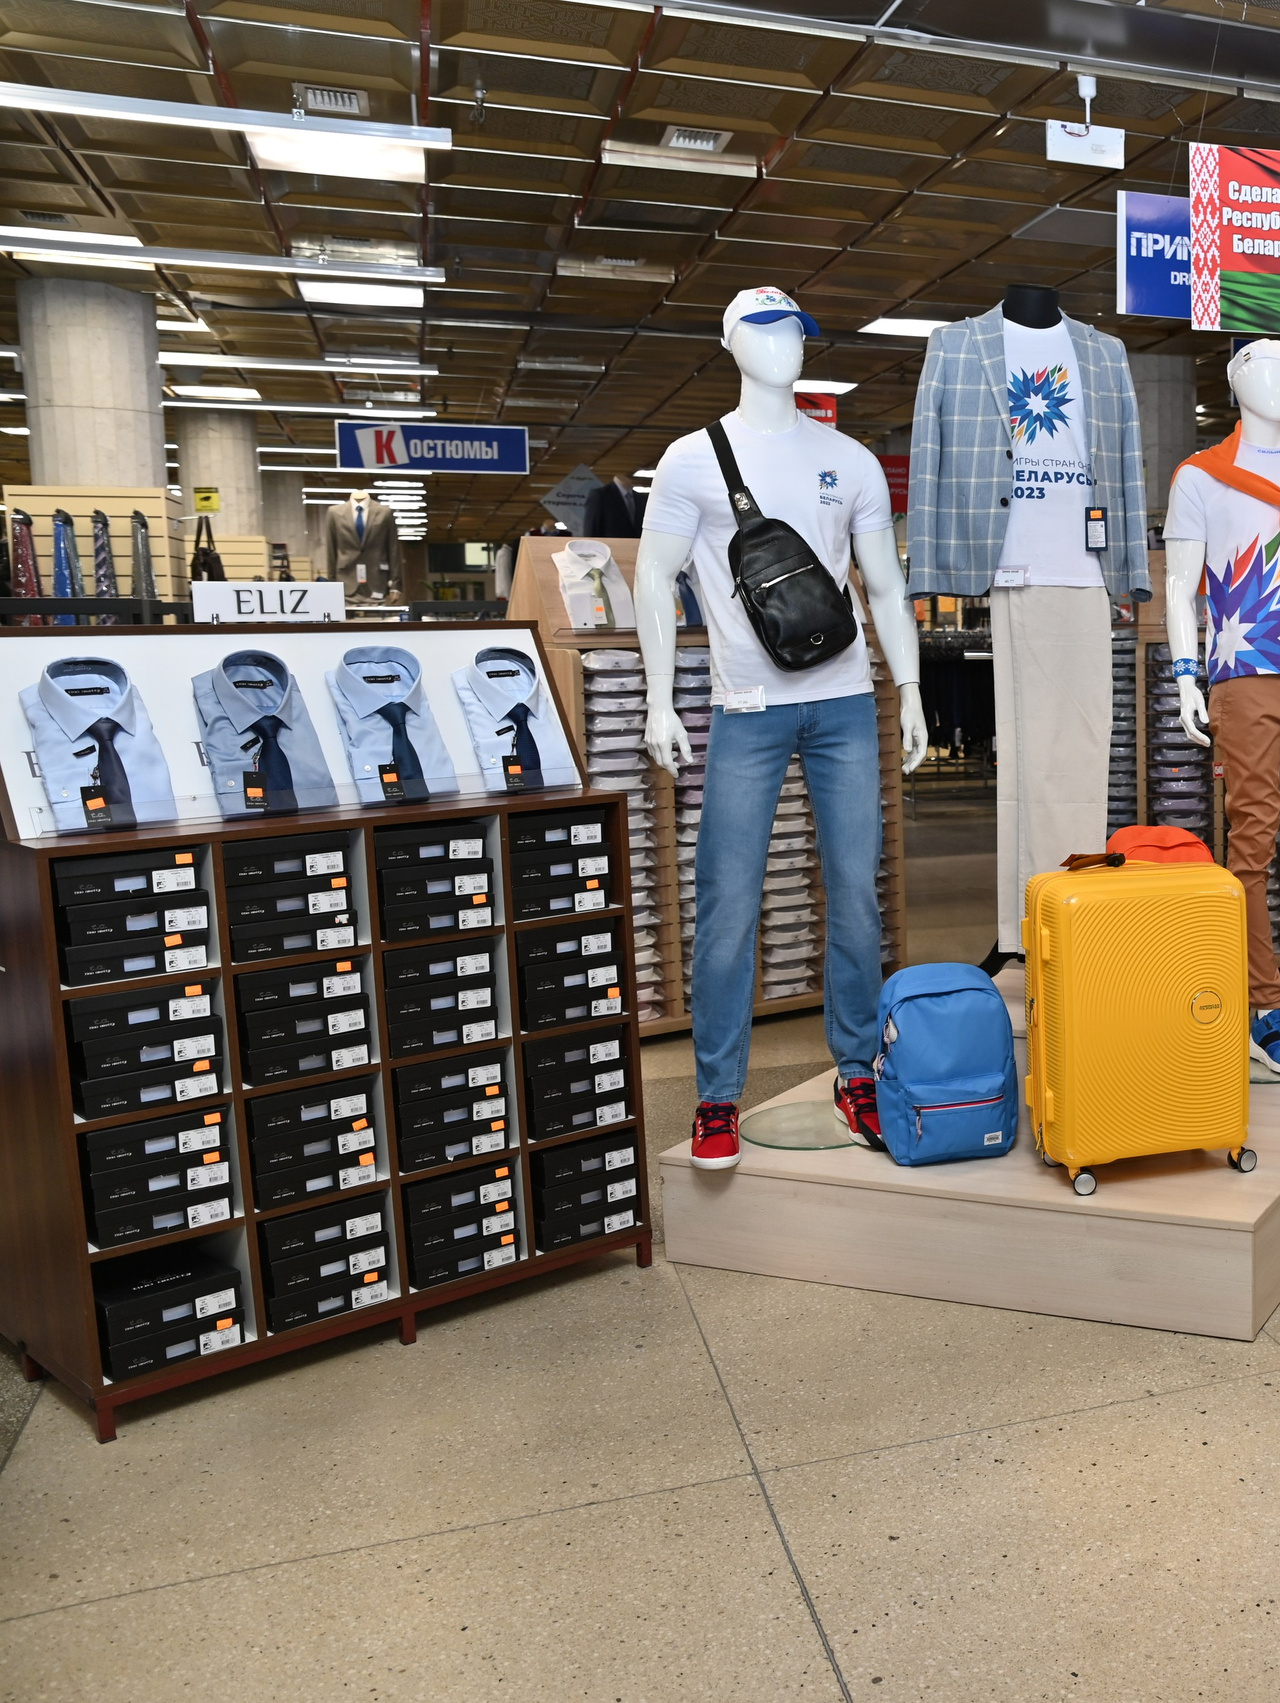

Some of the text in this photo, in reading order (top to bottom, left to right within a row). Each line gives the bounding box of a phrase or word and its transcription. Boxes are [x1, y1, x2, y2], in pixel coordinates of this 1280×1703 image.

[1170, 271, 1191, 286] DR
[1013, 457, 1040, 467] ИГРЫ
[1042, 458, 1076, 468] СТРАН
[1012, 470, 1093, 486] ЕЛАРУСЬ
[1011, 486, 1046, 499] 023
[232, 589, 310, 615] ELIZ
